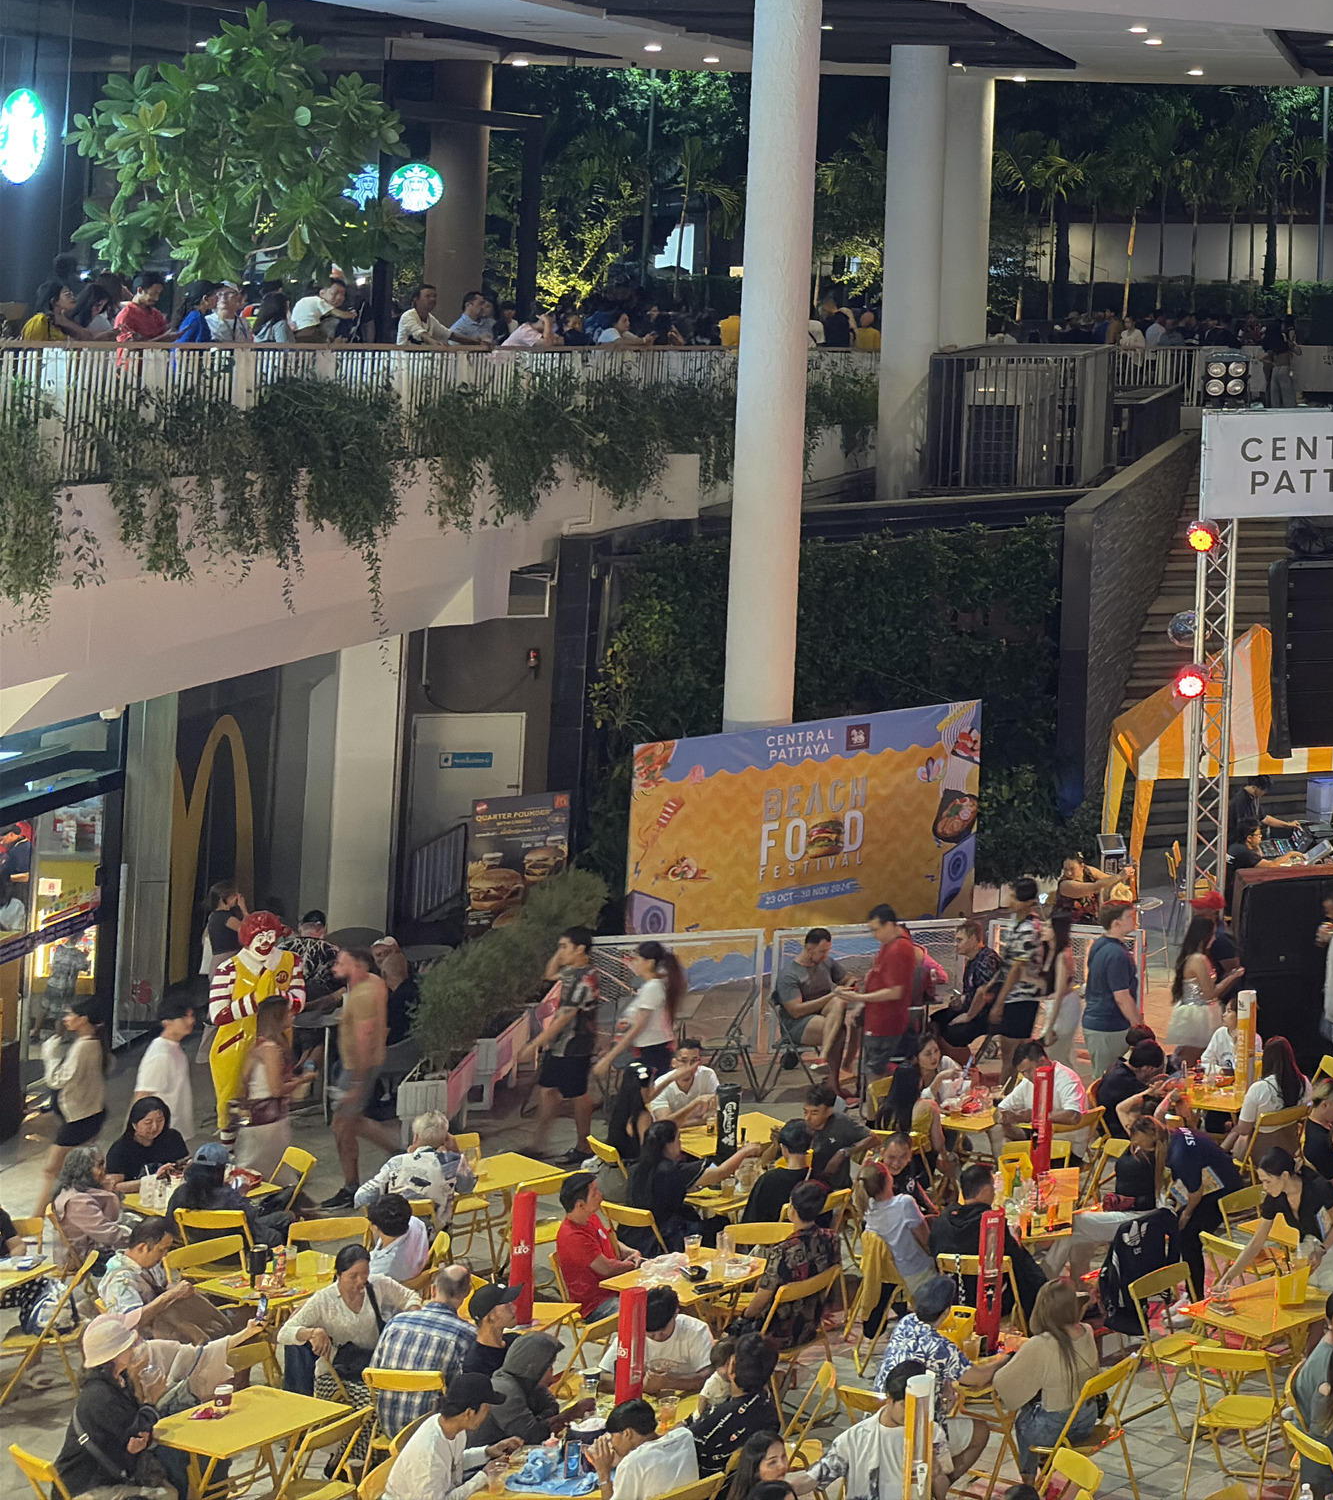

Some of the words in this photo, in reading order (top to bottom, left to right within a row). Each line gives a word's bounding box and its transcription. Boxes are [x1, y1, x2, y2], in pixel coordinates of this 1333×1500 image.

[766, 728, 835, 748] CENTRAL
[769, 742, 830, 761] PATTAYA
[762, 775, 868, 822] BEACH
[760, 809, 864, 866] FOD
[759, 851, 862, 882] FESTIVAL
[764, 895, 776, 904] 23
[777, 892, 794, 903] OCT
[812, 886, 829, 897] NOV
[513, 1246, 530, 1255] LEO
